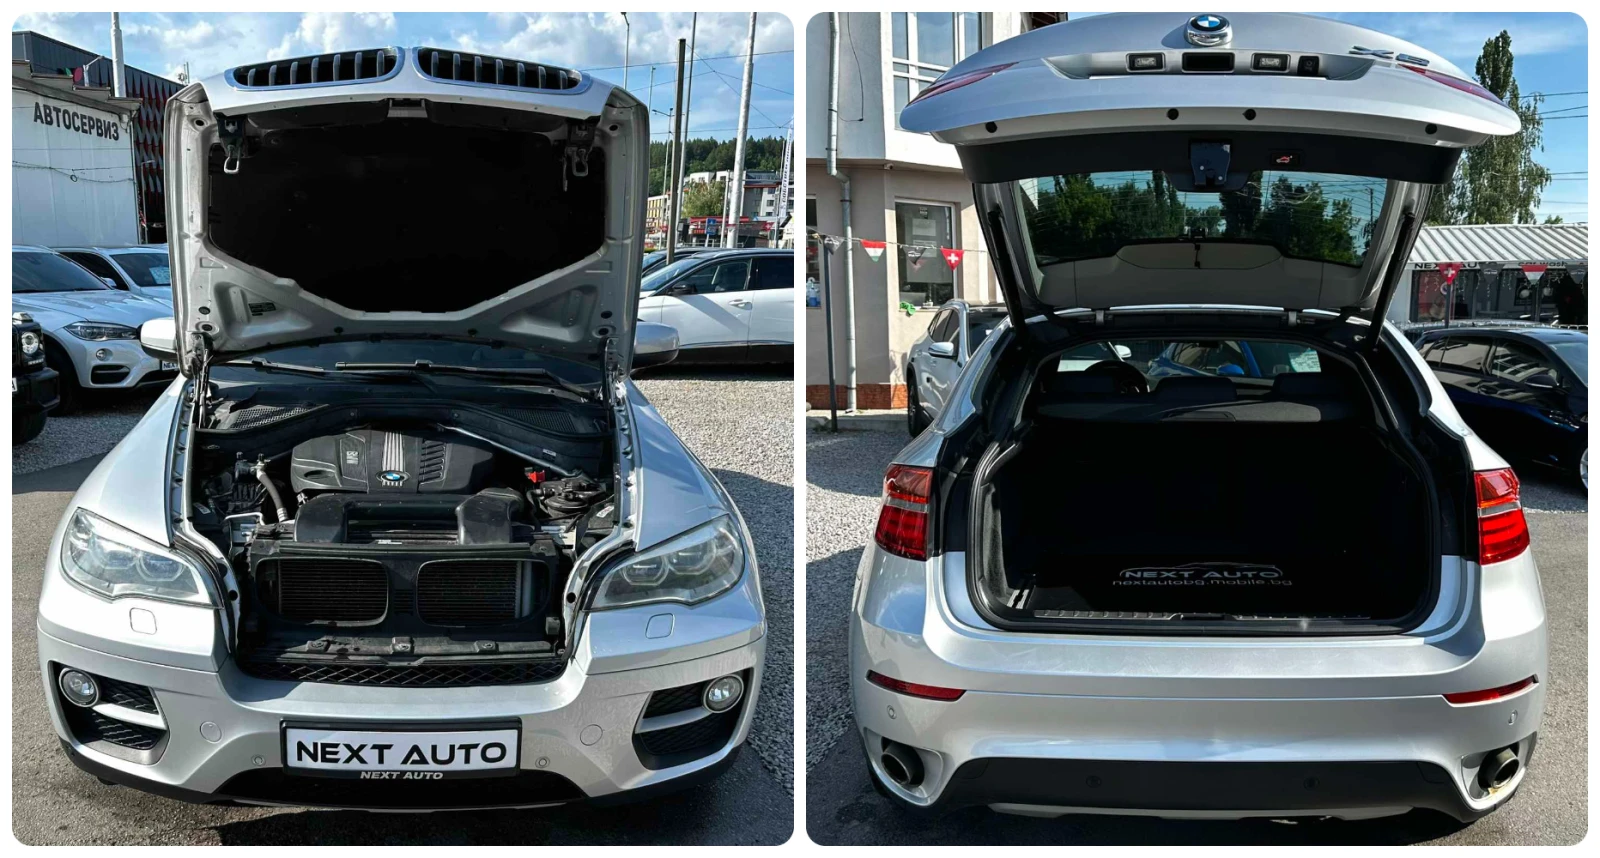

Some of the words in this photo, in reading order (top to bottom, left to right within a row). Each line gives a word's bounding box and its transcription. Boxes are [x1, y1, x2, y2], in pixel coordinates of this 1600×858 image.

[33, 101, 119, 141] АВТОСЕРВИЗ
[296, 740, 394, 765] NEXT
[400, 742, 507, 766] AUTO
[360, 771, 401, 780] NEXT
[403, 771, 444, 780] AUTO
